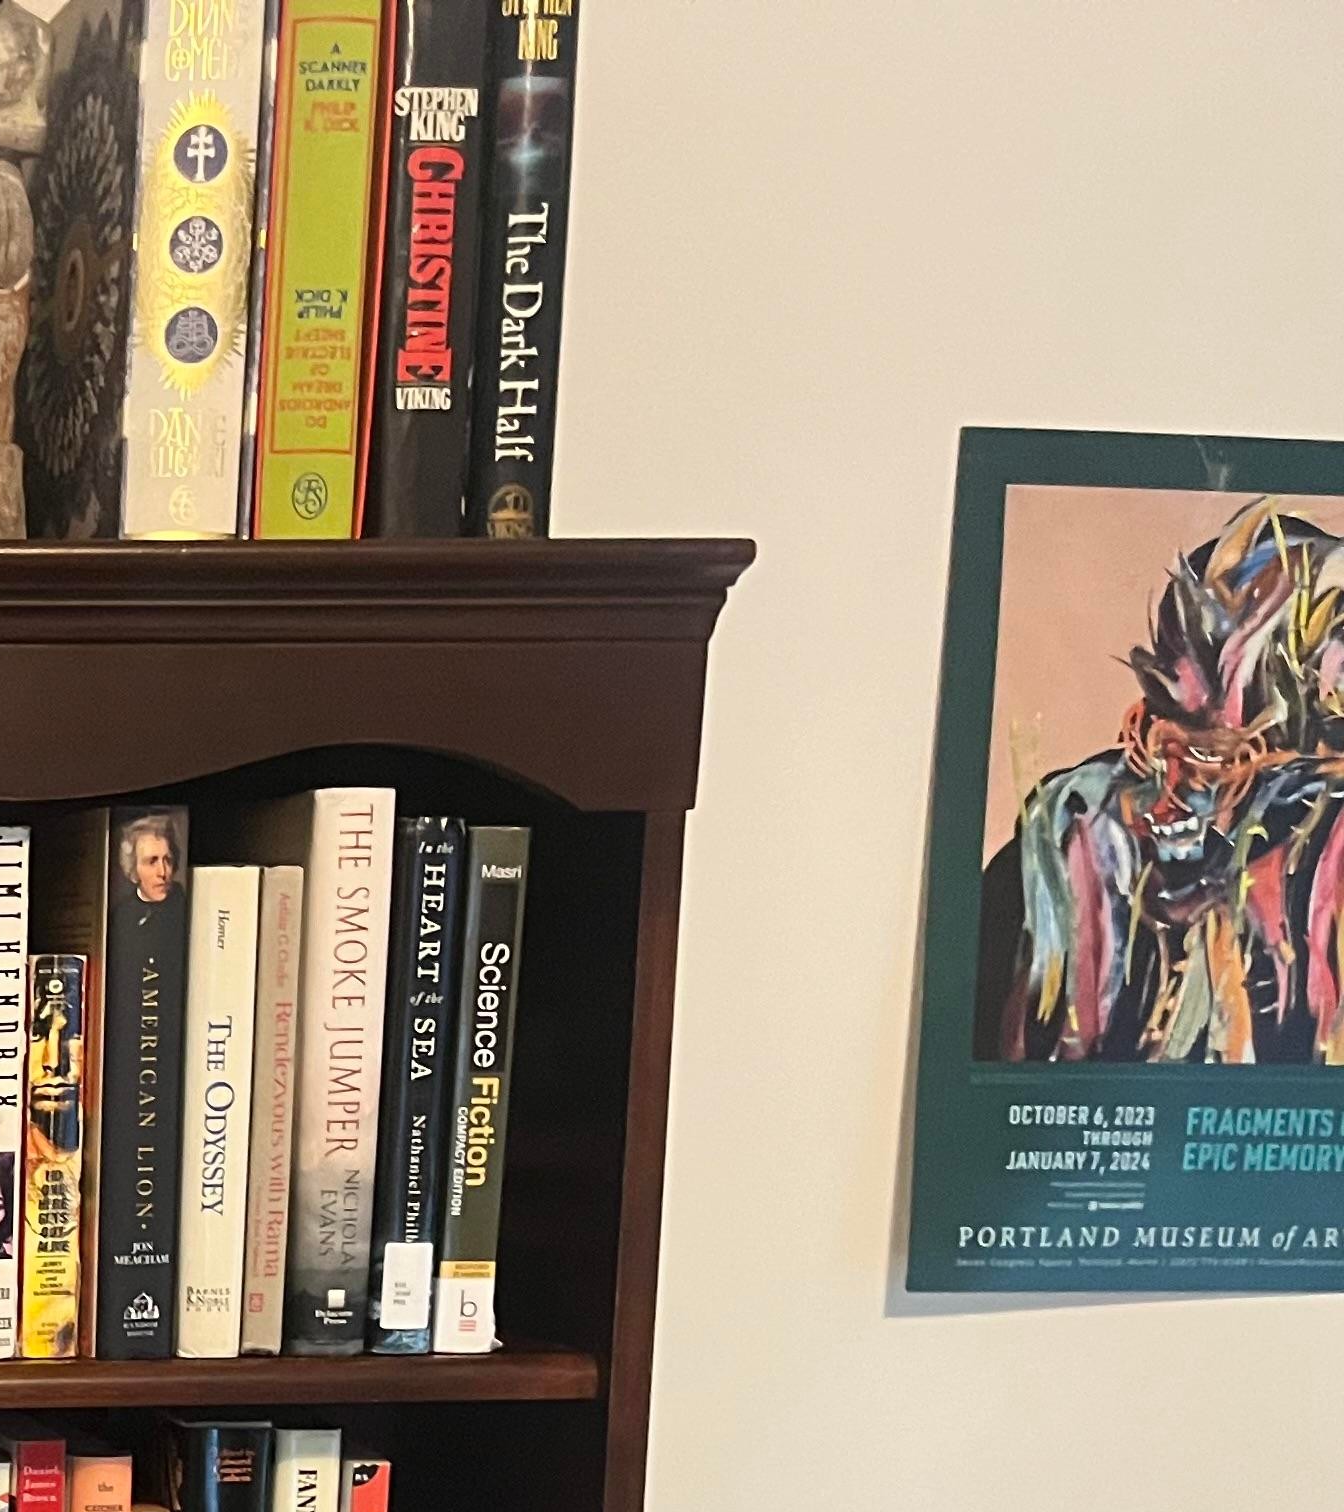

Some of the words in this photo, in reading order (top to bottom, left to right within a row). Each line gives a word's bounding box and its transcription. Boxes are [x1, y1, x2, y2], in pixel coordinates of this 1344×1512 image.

[299, 61, 368, 75] SCANNER
[395, 87, 478, 117] STEPHEN
[410, 111, 465, 142] KING
[397, 147, 464, 382] CHRISTINE
[505, 202, 549, 275] The
[500, 281, 543, 373] Dark
[396, 386, 451, 410] VIKING
[494, 380, 539, 462] Half
[338, 804, 373, 870] THE
[481, 864, 522, 880] Masri
[332, 887, 370, 1010] SMOKE
[417, 864, 447, 983] HEART
[474, 942, 510, 1068] Science
[139, 967, 159, 1128] AMERICAN
[410, 1017, 437, 1080] SEA
[323, 1022, 363, 1157] JUMPER
[1008, 1105, 1089, 1125] OCTOBER
[1093, 1106, 1108, 1129] 6,
[1114, 1106, 1155, 1126] 2023
[200, 1081, 235, 1217] ODYSSEY
[453, 1106, 469, 1168] COMPACT
[465, 1076, 500, 1186] Fiction
[1083, 1130, 1153, 1146] THROUGH
[1186, 1107, 1334, 1137] FRAGMENTS
[136, 1146, 155, 1219] LION
[1006, 1151, 1087, 1170] JANUARY
[1090, 1151, 1104, 1176] 7,
[1109, 1151, 1150, 1171] 2024
[1183, 1142, 1239, 1171] EPIC
[1243, 1143, 1344, 1172] MEMORY
[131, 1241, 154, 1254] JON
[319, 1189, 337, 1256] EVANS
[958, 1226, 1120, 1249] PORTLAND
[1132, 1226, 1261, 1249] MUSEUM
[1272, 1224, 1298, 1251] of
[1303, 1226, 1344, 1249] AR
[114, 1253, 170, 1265] MEACHAM
